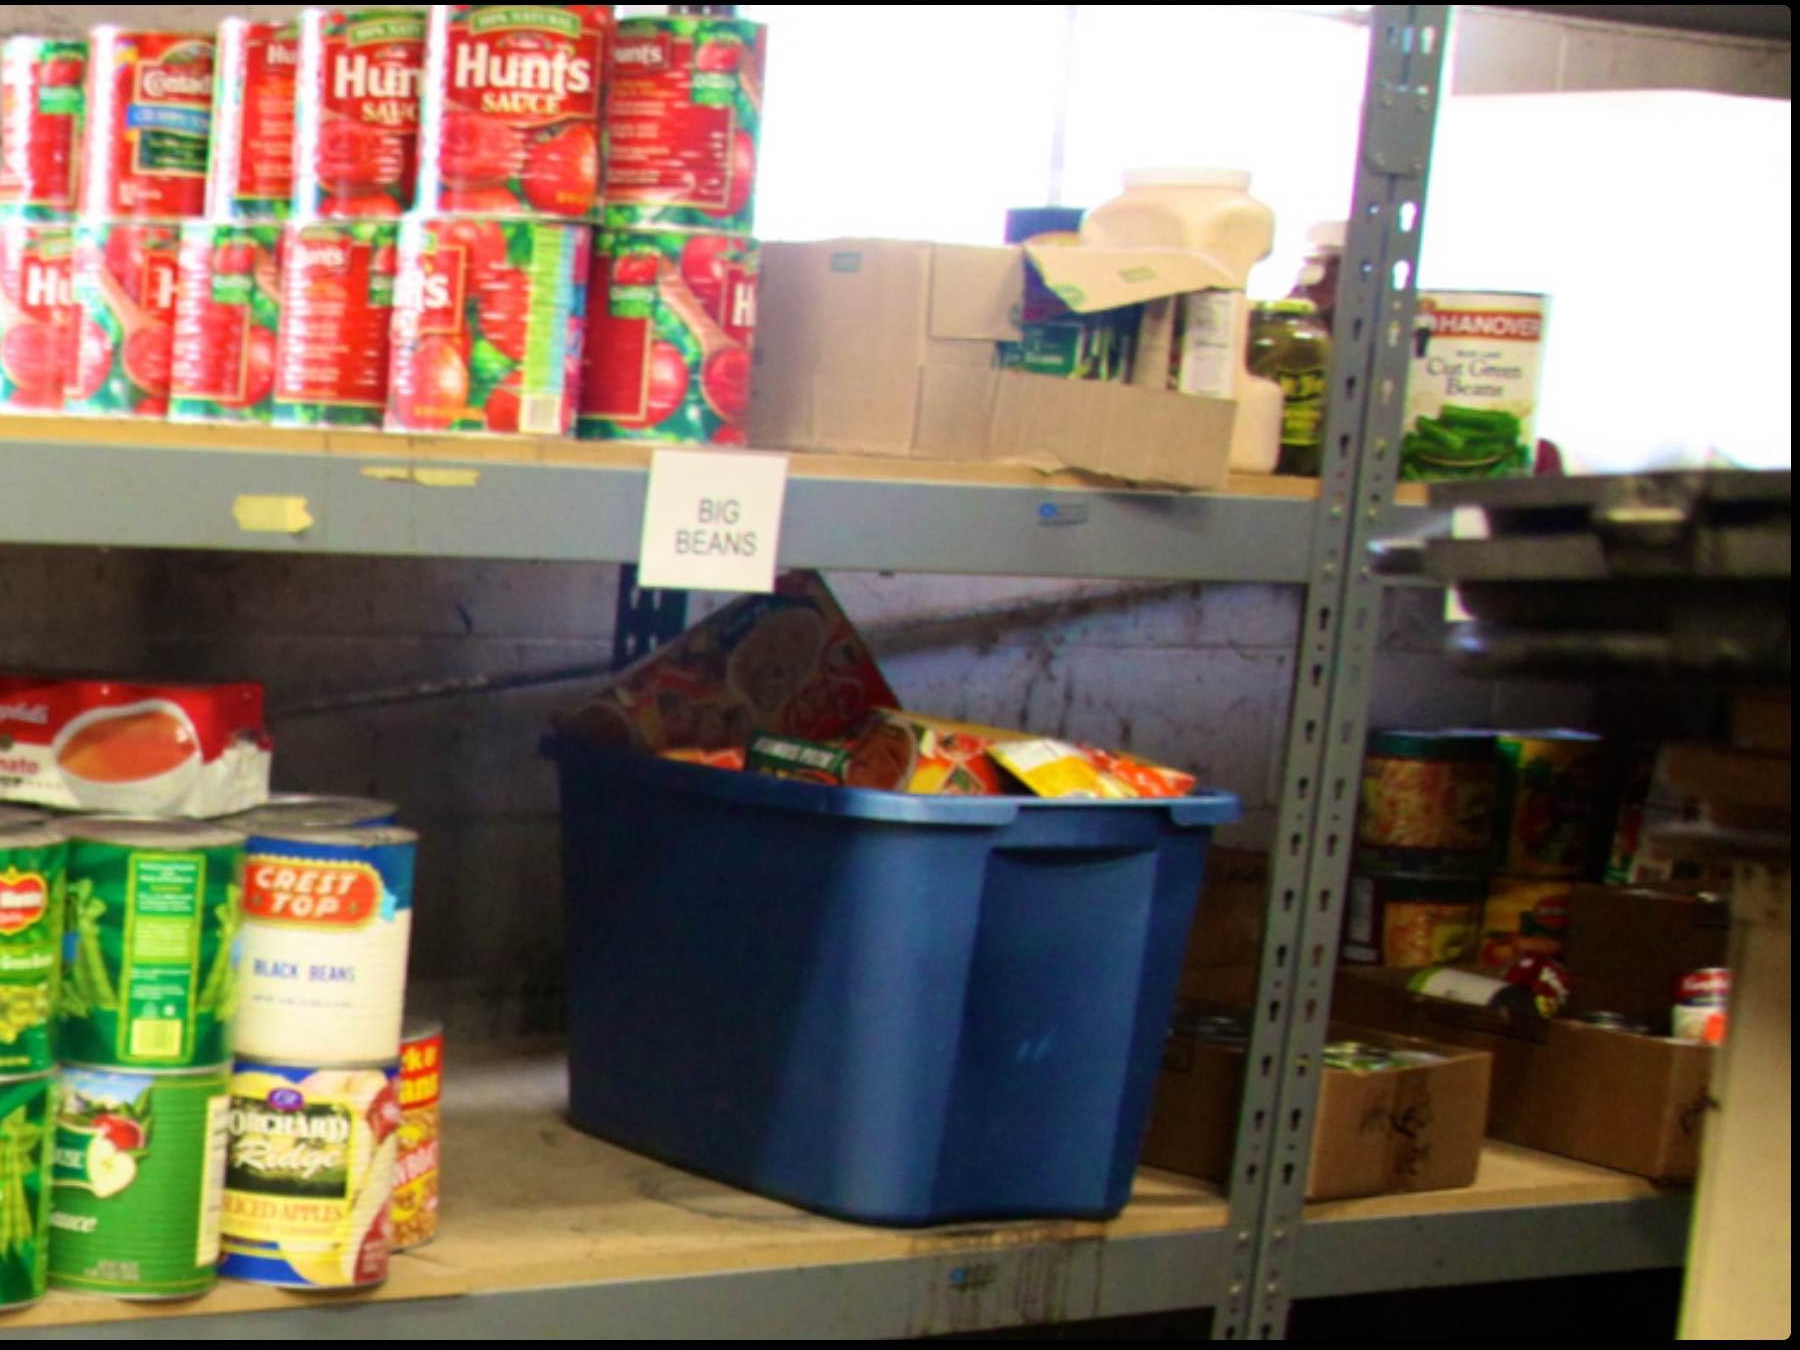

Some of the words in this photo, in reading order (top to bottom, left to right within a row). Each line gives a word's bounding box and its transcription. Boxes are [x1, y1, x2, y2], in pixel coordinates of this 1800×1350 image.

[481, 90, 561, 115] SAUCE
[698, 498, 741, 525] BIG
[675, 528, 758, 557] BEANS
[254, 866, 357, 896] CREST
[270, 892, 341, 918] TOP
[230, 1109, 351, 1144] ORCHARD
